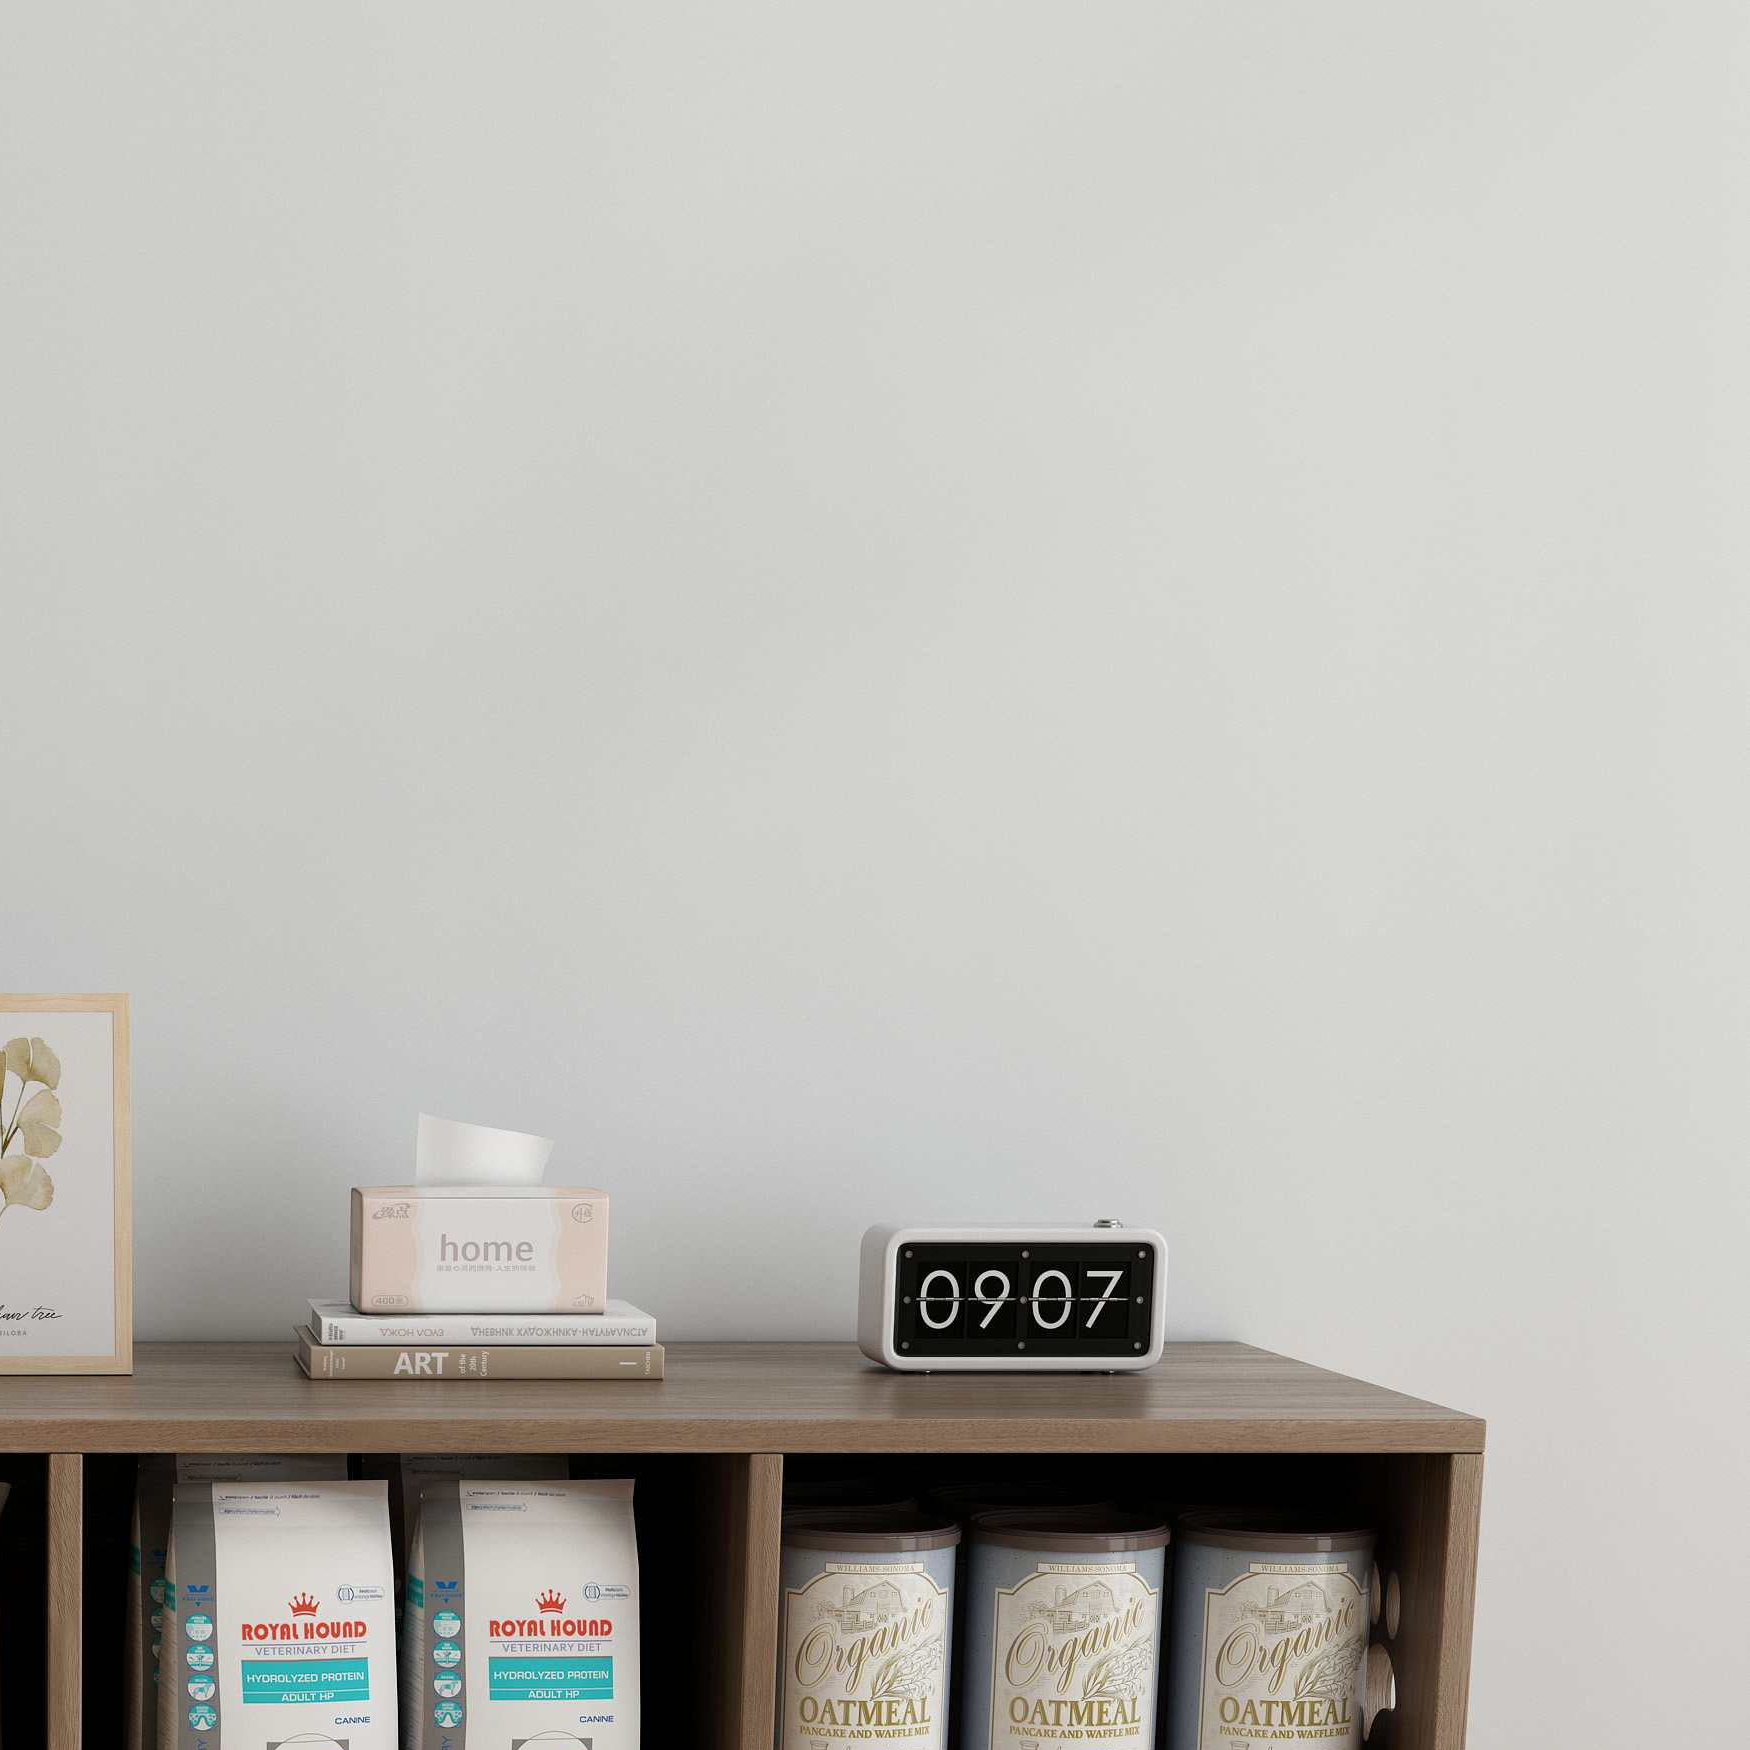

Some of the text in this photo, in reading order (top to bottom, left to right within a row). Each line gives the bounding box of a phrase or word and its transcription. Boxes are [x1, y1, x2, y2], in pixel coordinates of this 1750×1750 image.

[440, 1233, 533, 1261] home
[31, 1306, 64, 1320] tree
[394, 1352, 449, 1374] ART
[480, 1351, 490, 1376] Century
[242, 1621, 367, 1640] ROYAL HOUND
[490, 1620, 612, 1637] ROYAL HOUND
[255, 1645, 356, 1656] VETERINARY DIET
[502, 1643, 601, 1652] VETERINARY DIET
[795, 1597, 932, 1694] Organic
[1005, 1597, 1145, 1694] Organic
[1215, 1598, 1355, 1695] Organic
[247, 1672, 364, 1683] HYDROLYZED PROTEIN
[494, 1671, 609, 1680] HYDROLYZED PROTEIN
[282, 1693, 316, 1702] ADULT
[566, 1690, 580, 1698] HP
[800, 1696, 931, 1726] OATMEAL
[1010, 1696, 1141, 1726] OATMEAL
[1220, 1696, 1351, 1726] OATMEAL
[335, 1716, 370, 1725] CANINE
[800, 1726, 930, 1738] PANCAKE AND WAFFLE MIX
[1010, 1726, 1140, 1739] PANCAKE AND WAFFLE MIX
[1220, 1726, 1351, 1739] PANCAKE AND WAFFLE MIX
